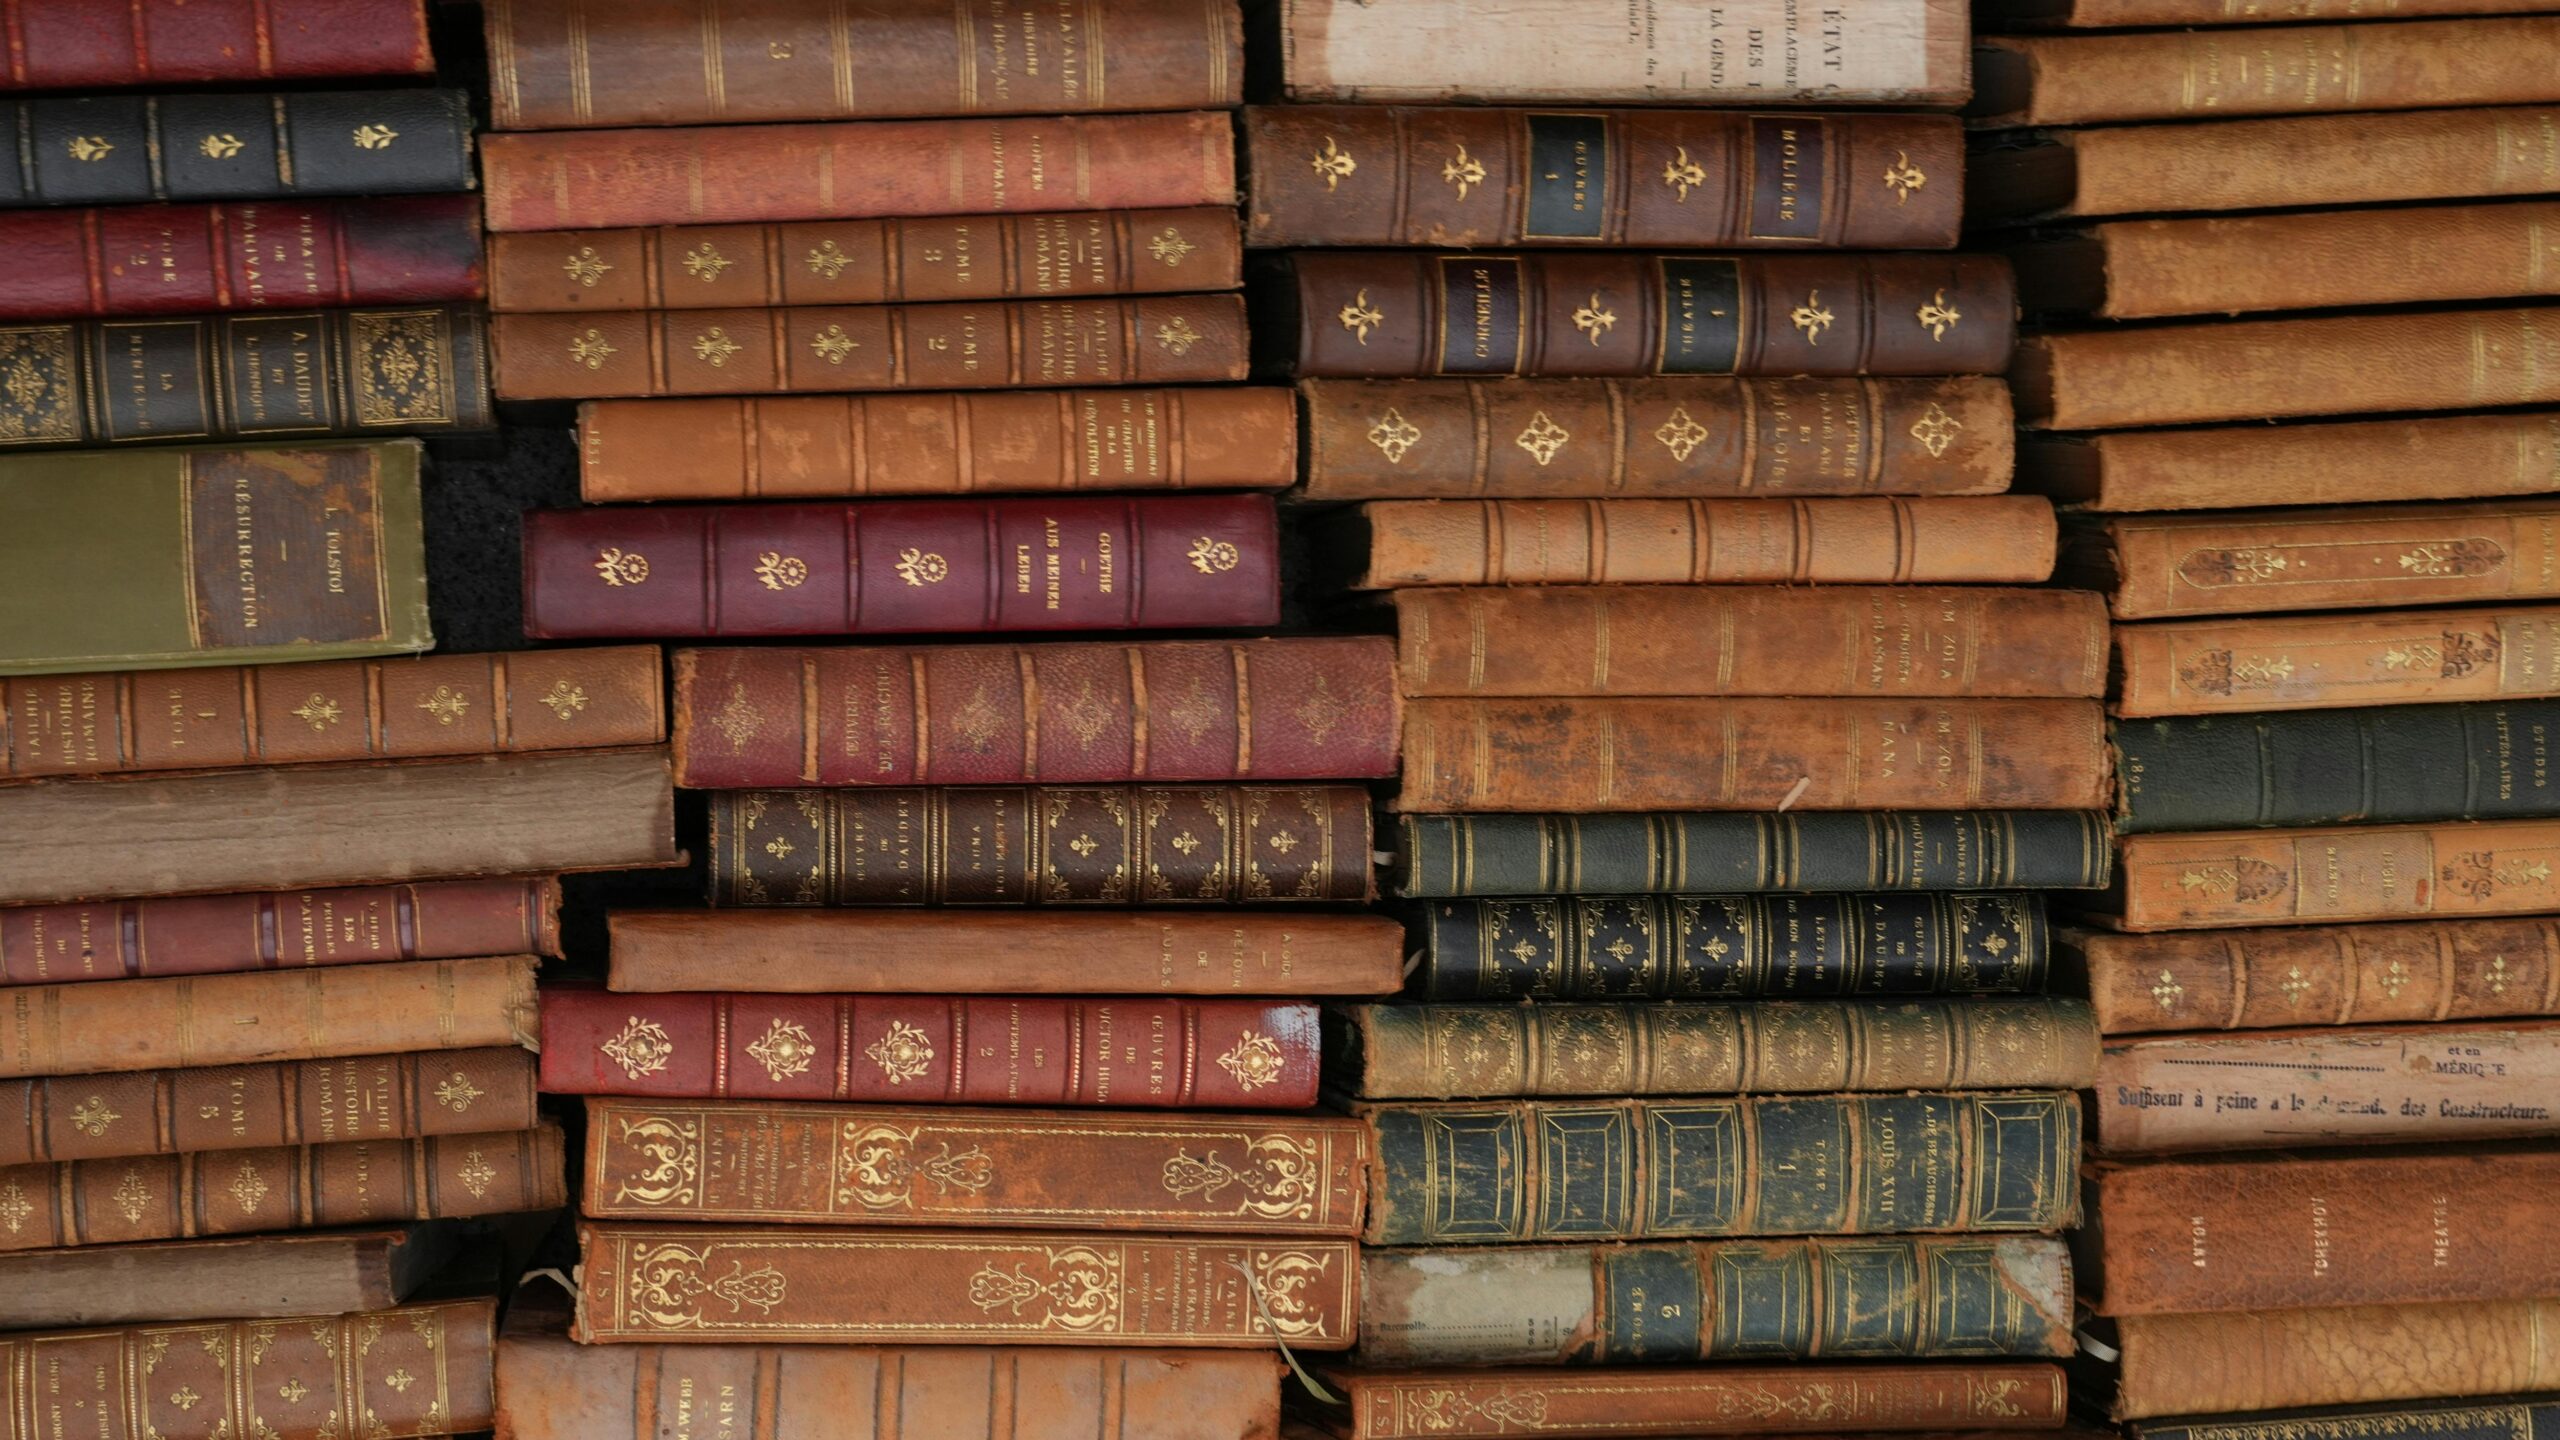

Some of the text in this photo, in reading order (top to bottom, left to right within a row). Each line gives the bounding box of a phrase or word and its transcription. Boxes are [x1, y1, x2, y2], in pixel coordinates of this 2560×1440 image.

[1709, 9, 1723, 28] LA
[1822, 9, 1847, 70] ÉTAT
[768, 40, 793, 59] 3
[1747, 30, 1763, 67] DES
[1031, 135, 1043, 191] CONTES
[160, 230, 176, 283] TOME
[242, 209, 264, 306] MARIVAUX
[924, 249, 943, 261] 3
[956, 225, 971, 283] TOME
[1035, 217, 1051, 294] ROMAINE
[1055, 218, 1072, 290] HISTOIRE
[1090, 218, 1104, 285] TAILHIE
[1473, 269, 1493, 359] CORNEILLE
[928, 336, 947, 351] 2
[963, 314, 978, 370] TOME
[1039, 304, 1055, 381] ROMAINE
[1061, 304, 1077, 380] HISTOIRE
[1094, 309, 1108, 378] TAILHIE
[159, 371, 174, 392] LA
[271, 368, 285, 385] ET
[292, 331, 316, 421] A. DAUDET
[1106, 425, 1116, 455] DE LA
[1121, 419, 1134, 475] CHAPITRE
[1842, 393, 1859, 479] LETTRES
[324, 507, 340, 520] L.
[1017, 544, 1030, 594] LEBEN
[1045, 517, 1060, 610] AUS MEINEM
[1097, 532, 1112, 594] GOETHE
[24, 687, 42, 760] TAILHIE
[58, 685, 78, 766] HISTOIRE
[81, 681, 99, 762] ROMAINE
[168, 687, 185, 749] TOME
[880, 750, 893, 772] DE
[1881, 721, 1896, 779] NANA
[2128, 756, 2145, 794] 1892
[880, 838, 889, 852] DE
[897, 797, 910, 870] DAUDET
[971, 825, 982, 870] NUMA
[1908, 815, 1924, 890] NOUVELLES
[1955, 831, 1968, 885] SANDEAU
[322, 901, 335, 955] FEUILLES
[343, 917, 356, 942] LES
[1786, 900, 1797, 913] DE
[1787, 919, 1799, 943] MON
[55, 939, 67, 954] DU
[1196, 951, 1208, 967] DE
[1231, 929, 1244, 988] RETOUR
[1280, 950, 1292, 980] GIDE
[1814, 917, 1827, 980] LETTRES
[1872, 922, 1887, 988] DAUDET
[1895, 942, 1905, 956] DE
[1912, 917, 1925, 977] ŒUVRES
[980, 1046, 995, 1057] 2
[1033, 1047, 1044, 1068] LES
[1096, 1006, 1113, 1103] VICTOR HUGO
[1125, 1046, 1137, 1063] DE
[1149, 1015, 1165, 1095] ŒUVRES
[2448, 1045, 2480, 1057] et en
[199, 1105, 220, 1119] 5
[231, 1077, 247, 1138] TOME
[318, 1066, 334, 1141] ROMAINE
[343, 1060, 358, 1136] HISTOIRE
[376, 1063, 391, 1133] TAILHIE
[710, 1122, 723, 1179] TAINE
[754, 1113, 768, 1169] FRANCE
[1815, 1139, 1826, 1191] TOME
[1880, 1116, 1896, 1214] LOUIS XVII
[753, 1173, 764, 1190] LA
[1153, 1287, 1167, 1302] VI
[1183, 1247, 1198, 1339] DE LA FRANCE
[1225, 1278, 1239, 1333] TAINE
[1631, 1285, 1646, 1340] TOME
[1661, 1304, 1681, 1319] 2
[74, 1399, 85, 1409] &
[98, 1399, 111, 1439] RISLER
[679, 1378, 692, 1422] WEBB
[720, 1385, 734, 1440] SARN
